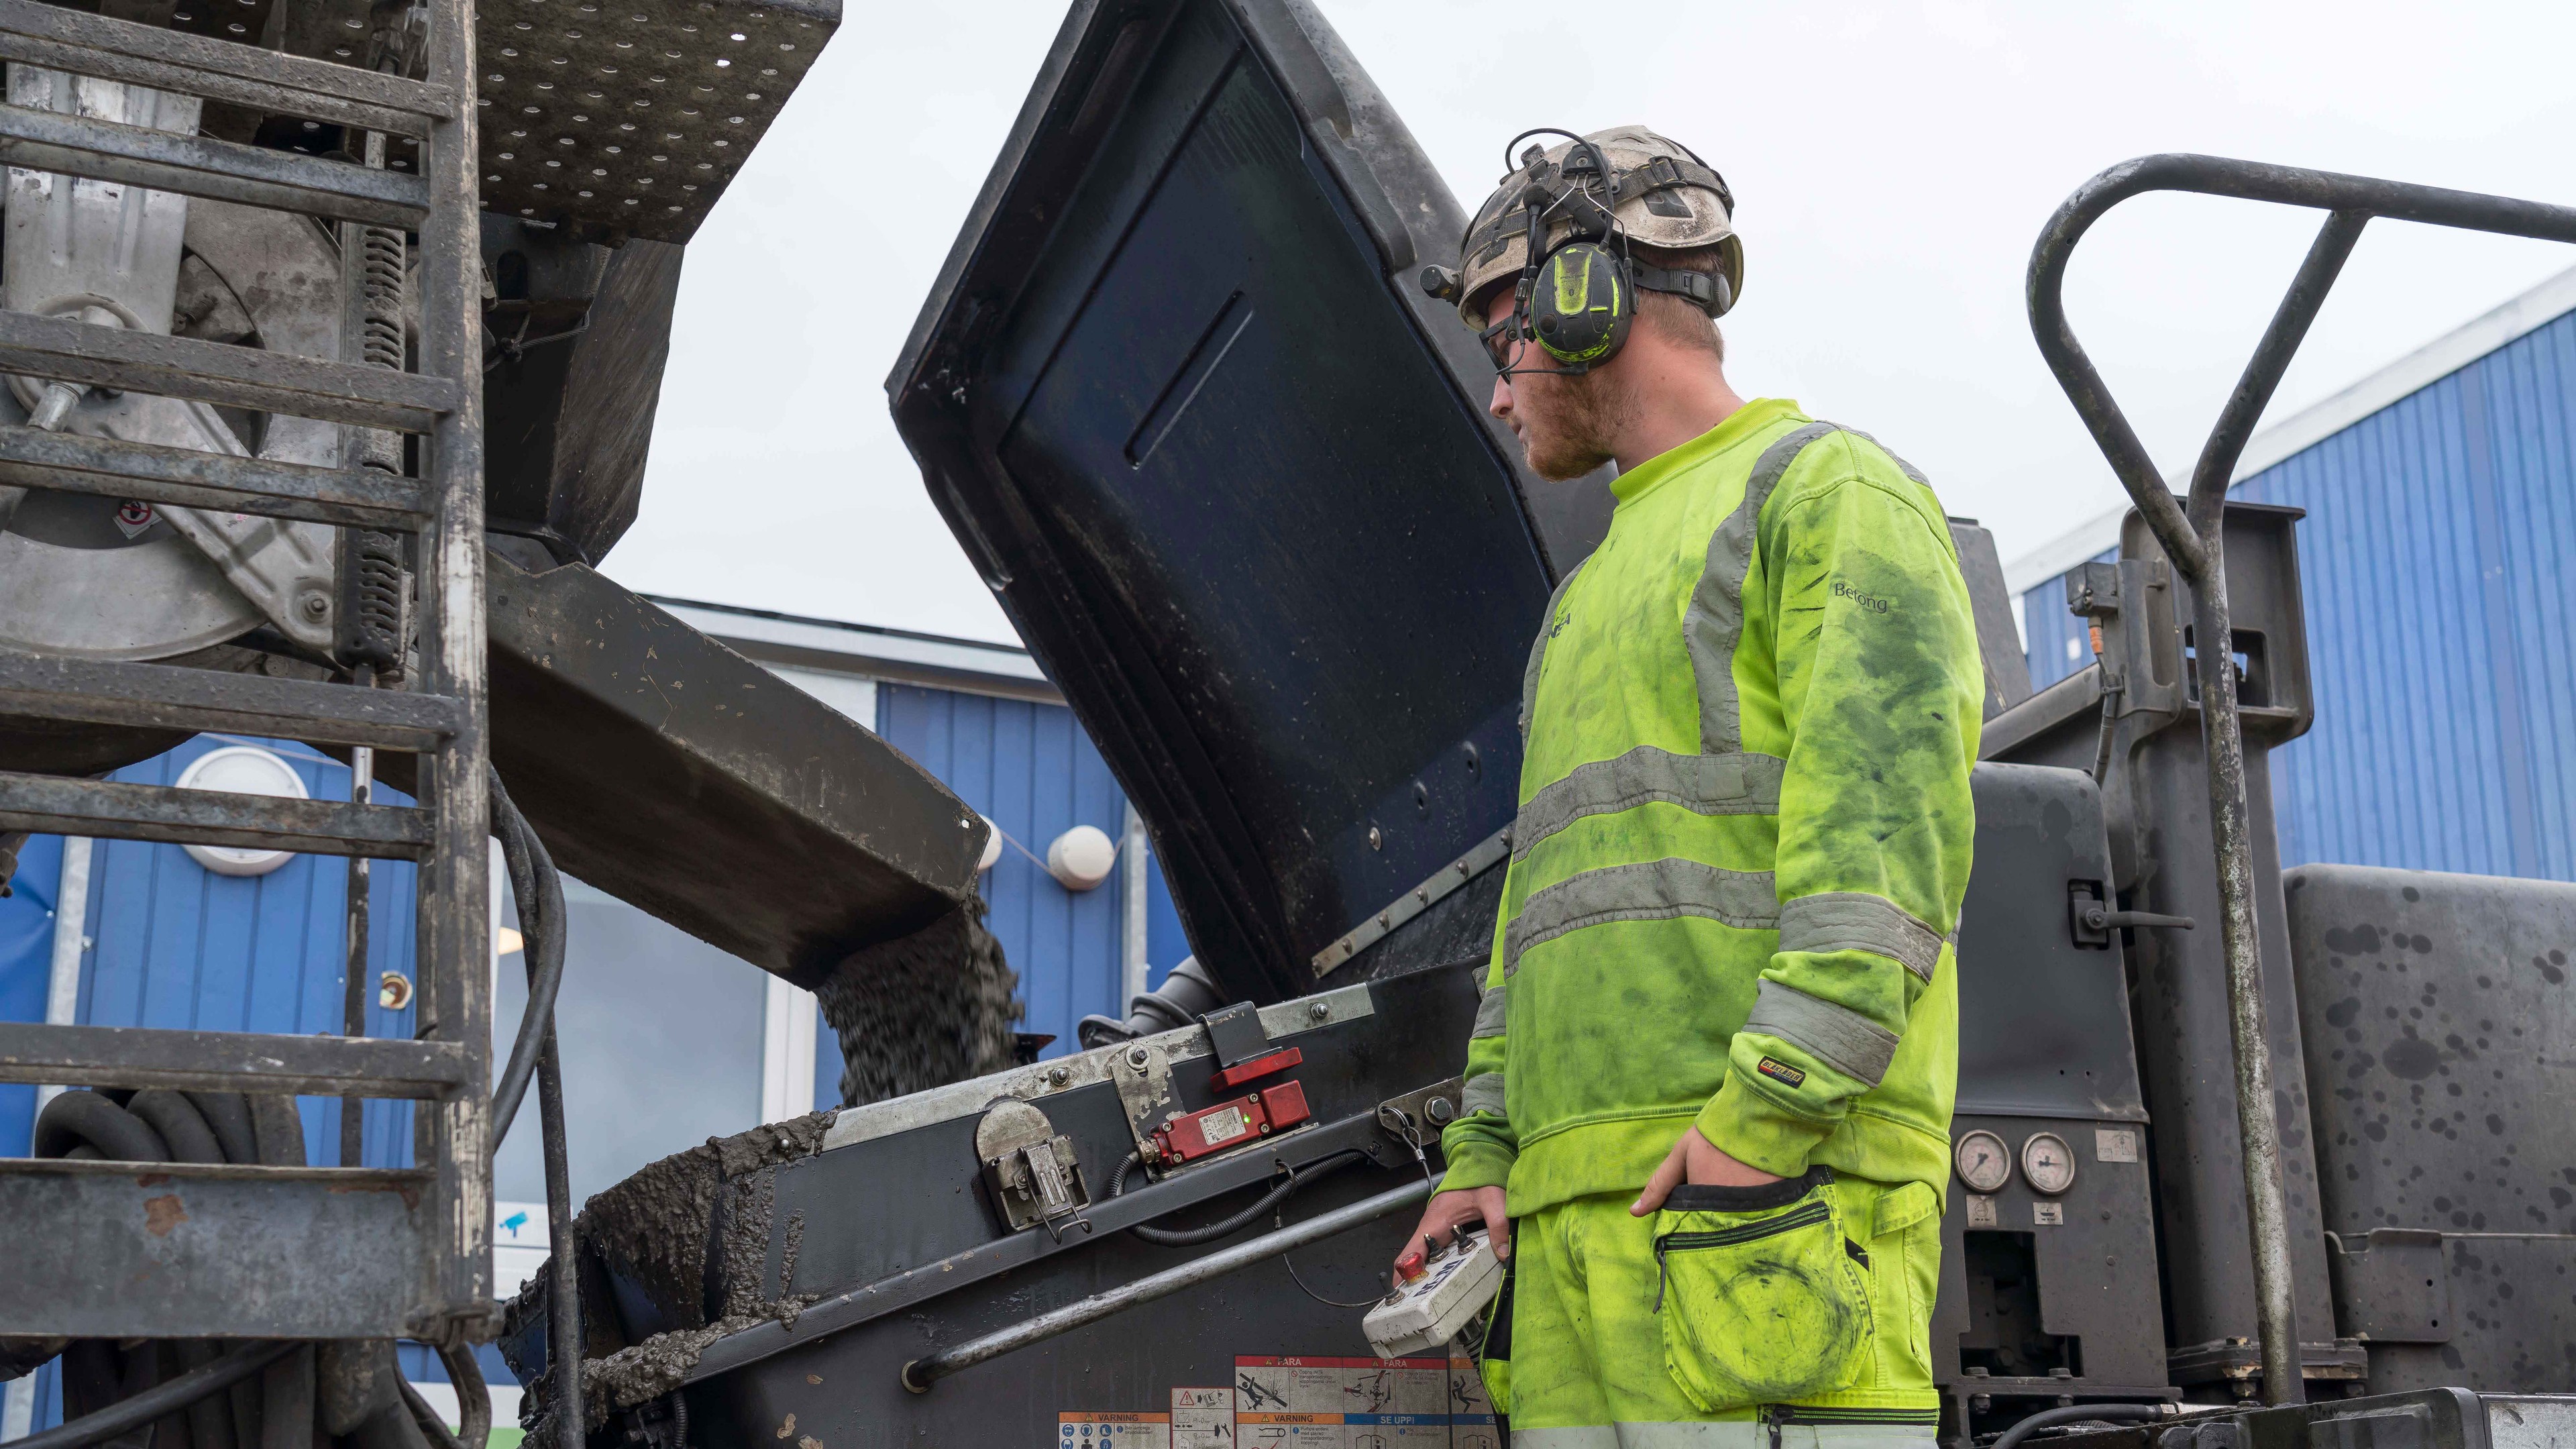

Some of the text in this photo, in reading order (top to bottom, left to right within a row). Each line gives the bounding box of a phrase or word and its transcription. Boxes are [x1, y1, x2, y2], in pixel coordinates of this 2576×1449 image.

[1835, 583, 1887, 614] Betong
[1762, 1061, 1800, 1081] BLÅKLÄDER
[1277, 1358, 1301, 1366] FARA
[1384, 1359, 1407, 1368] FARA
[1098, 1413, 1139, 1421] VARNING
[1380, 1416, 1415, 1424] SE UPP!
